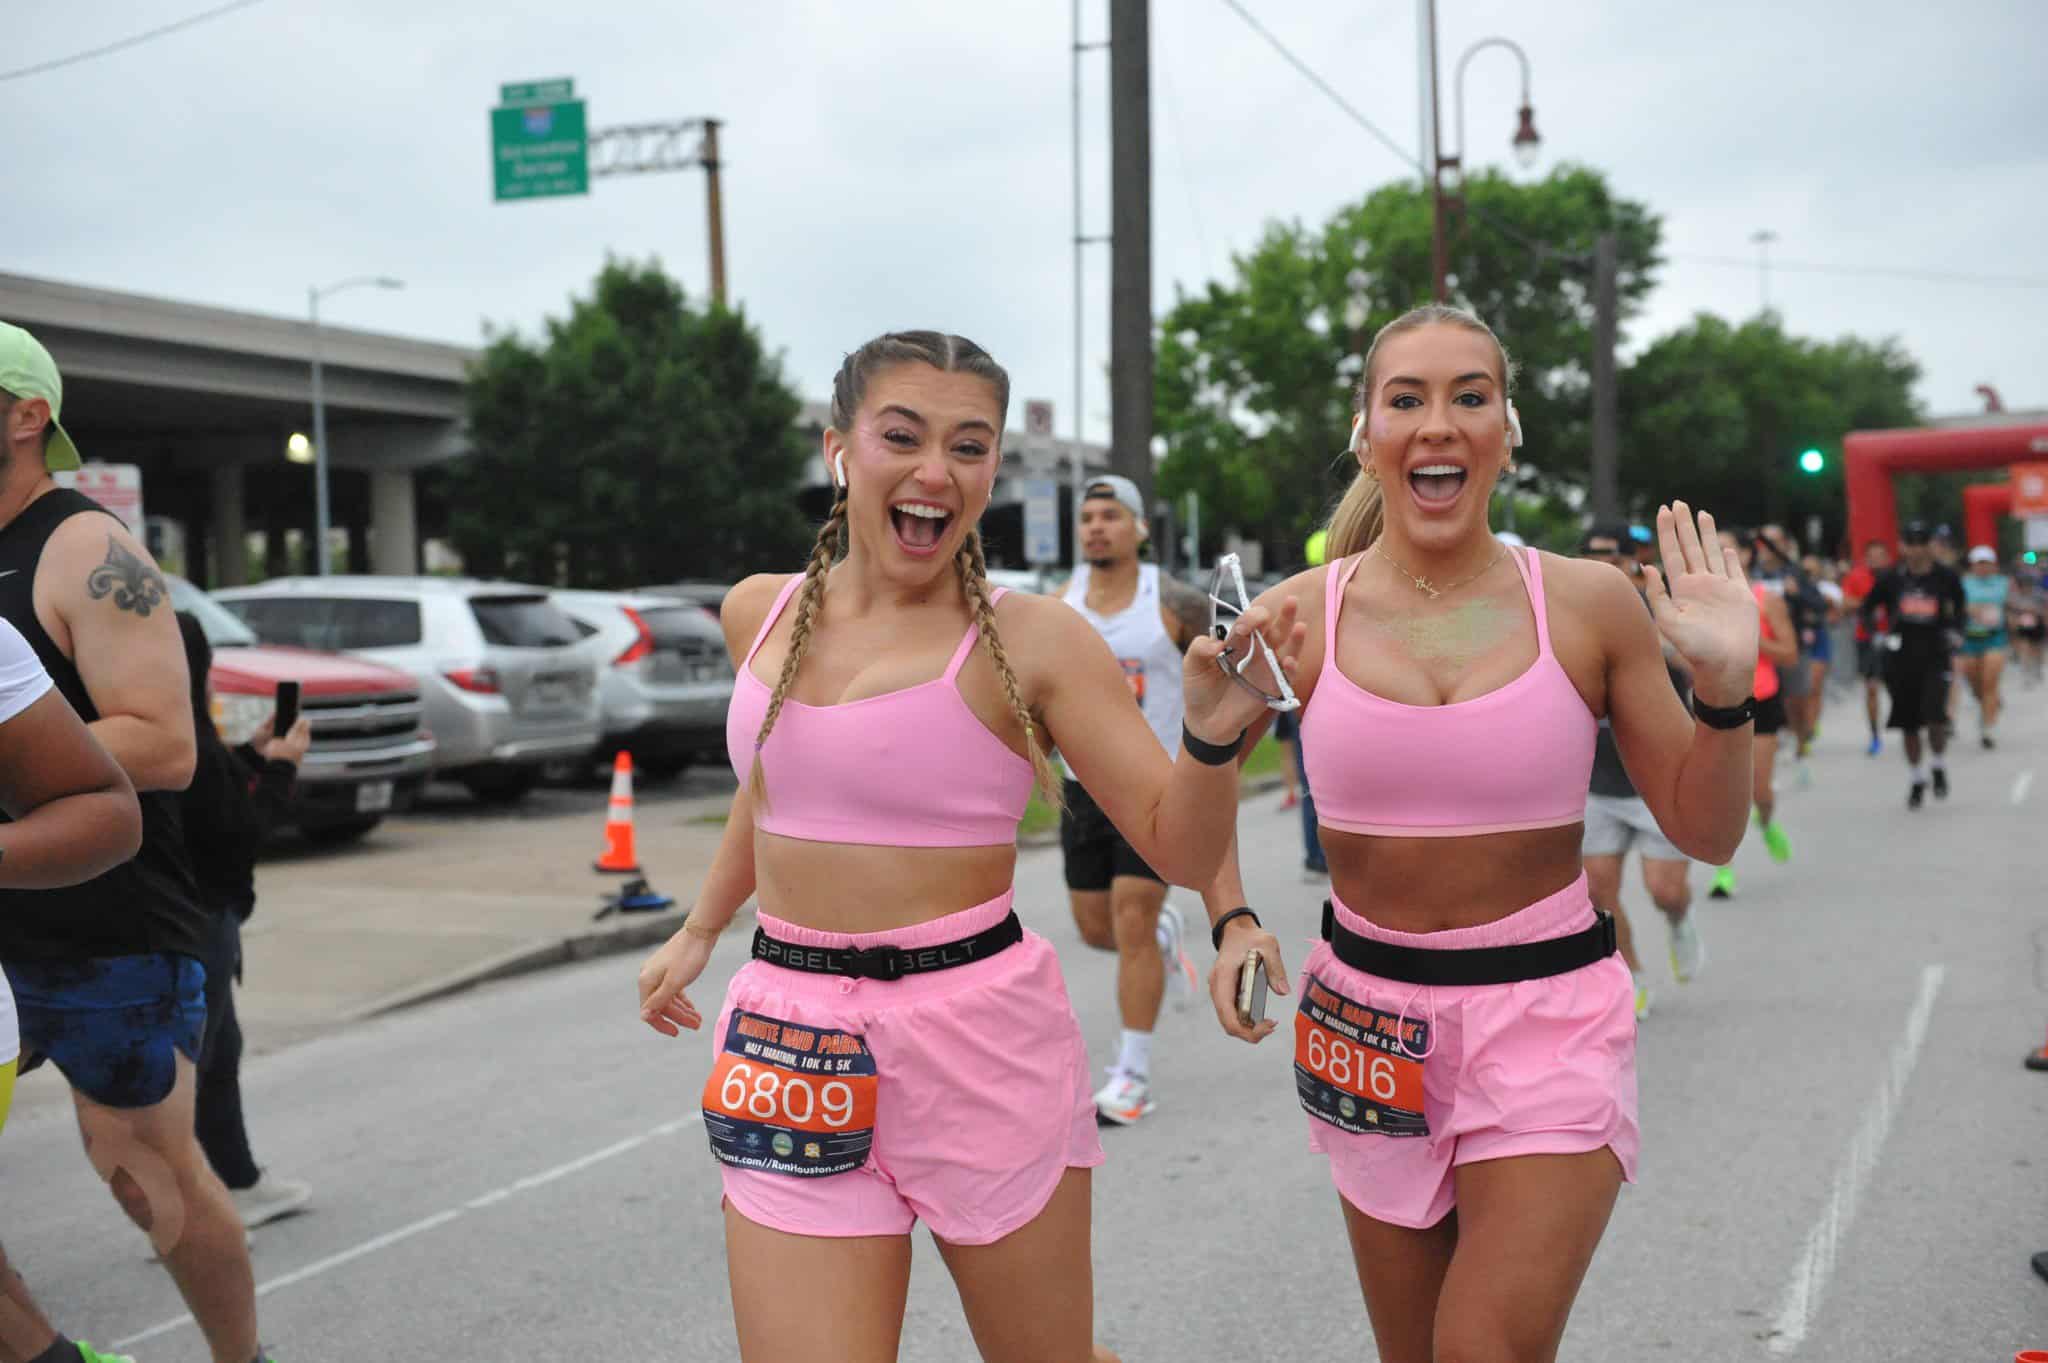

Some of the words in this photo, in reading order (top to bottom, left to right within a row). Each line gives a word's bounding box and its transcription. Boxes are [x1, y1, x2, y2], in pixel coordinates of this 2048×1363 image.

[743, 1041, 763, 1056] HALF
[801, 1055, 820, 1070] 10K
[823, 1060, 833, 1070] &
[836, 1059, 852, 1072] 5K
[1308, 1028, 1396, 1099] 6816
[721, 1063, 853, 1127] 6809
